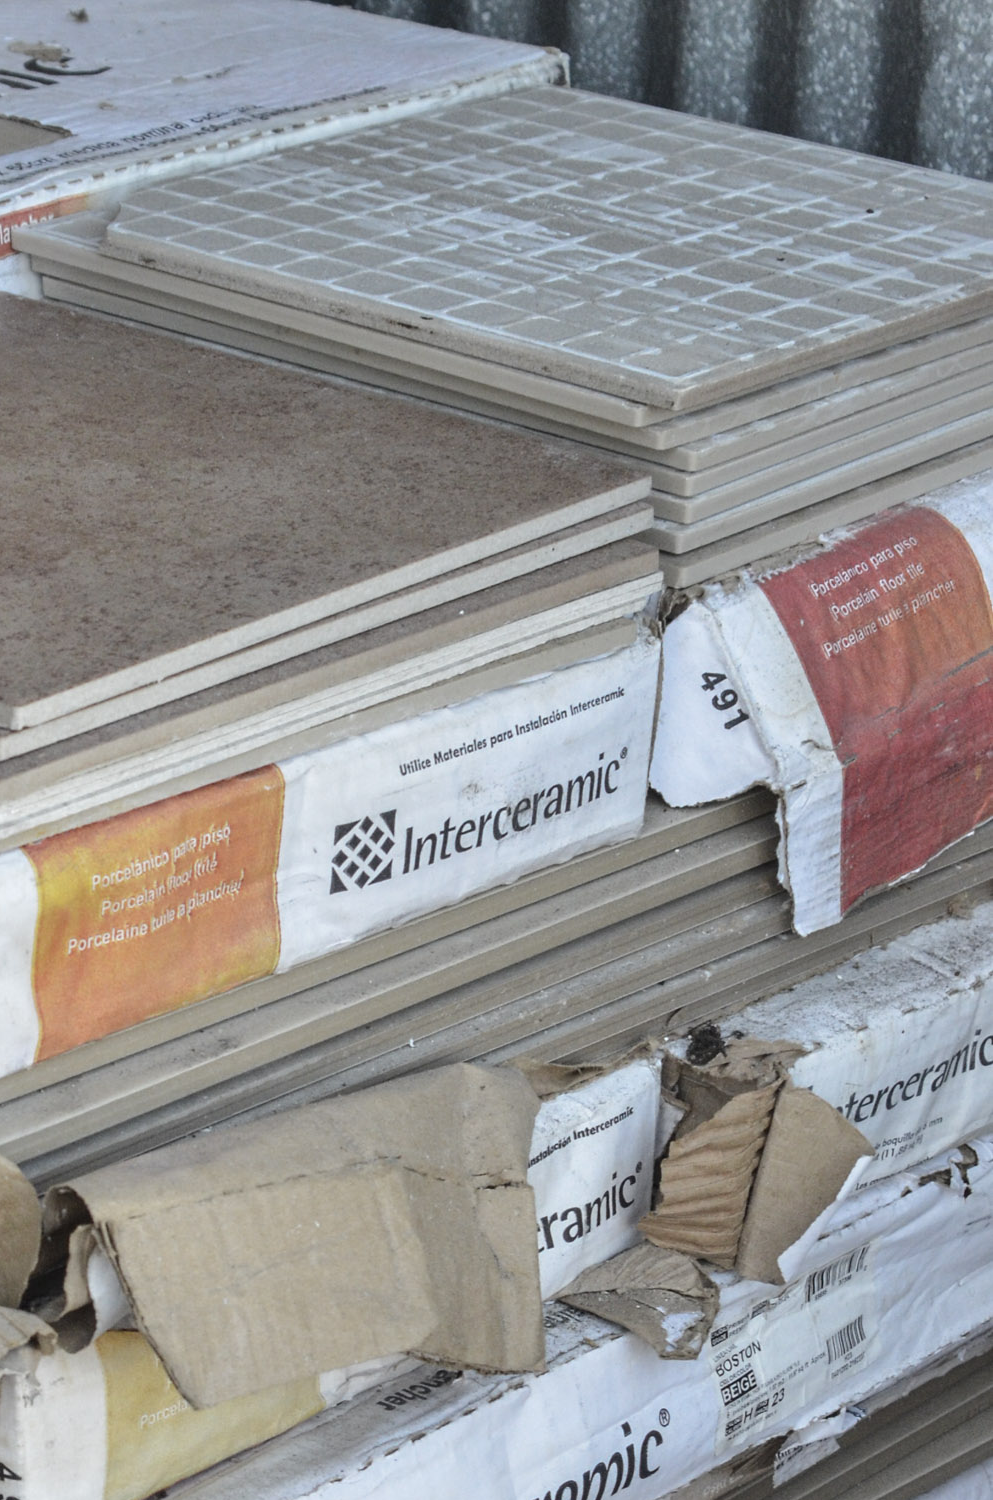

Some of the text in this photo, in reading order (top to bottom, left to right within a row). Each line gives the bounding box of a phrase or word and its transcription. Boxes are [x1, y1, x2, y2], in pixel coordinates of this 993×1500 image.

[870, 543, 895, 570] para
[895, 533, 919, 558] piso
[829, 572, 907, 622] Porcelain floor
[821, 622, 879, 660] Porcelaine
[700, 670, 751, 731] 491
[399, 686, 626, 779] Utilice Materiales para Instalación Interceramic
[91, 821, 232, 892] Porcelánico piso
[99, 879, 167, 918] Porcelain
[67, 905, 177, 957] Porcelaine tuile
[572, 1106, 635, 1141] Interceramic
[715, 1340, 762, 1378] BOSTON
[721, 1373, 757, 1404] BEIGE
[771, 1387, 786, 1407] 23
